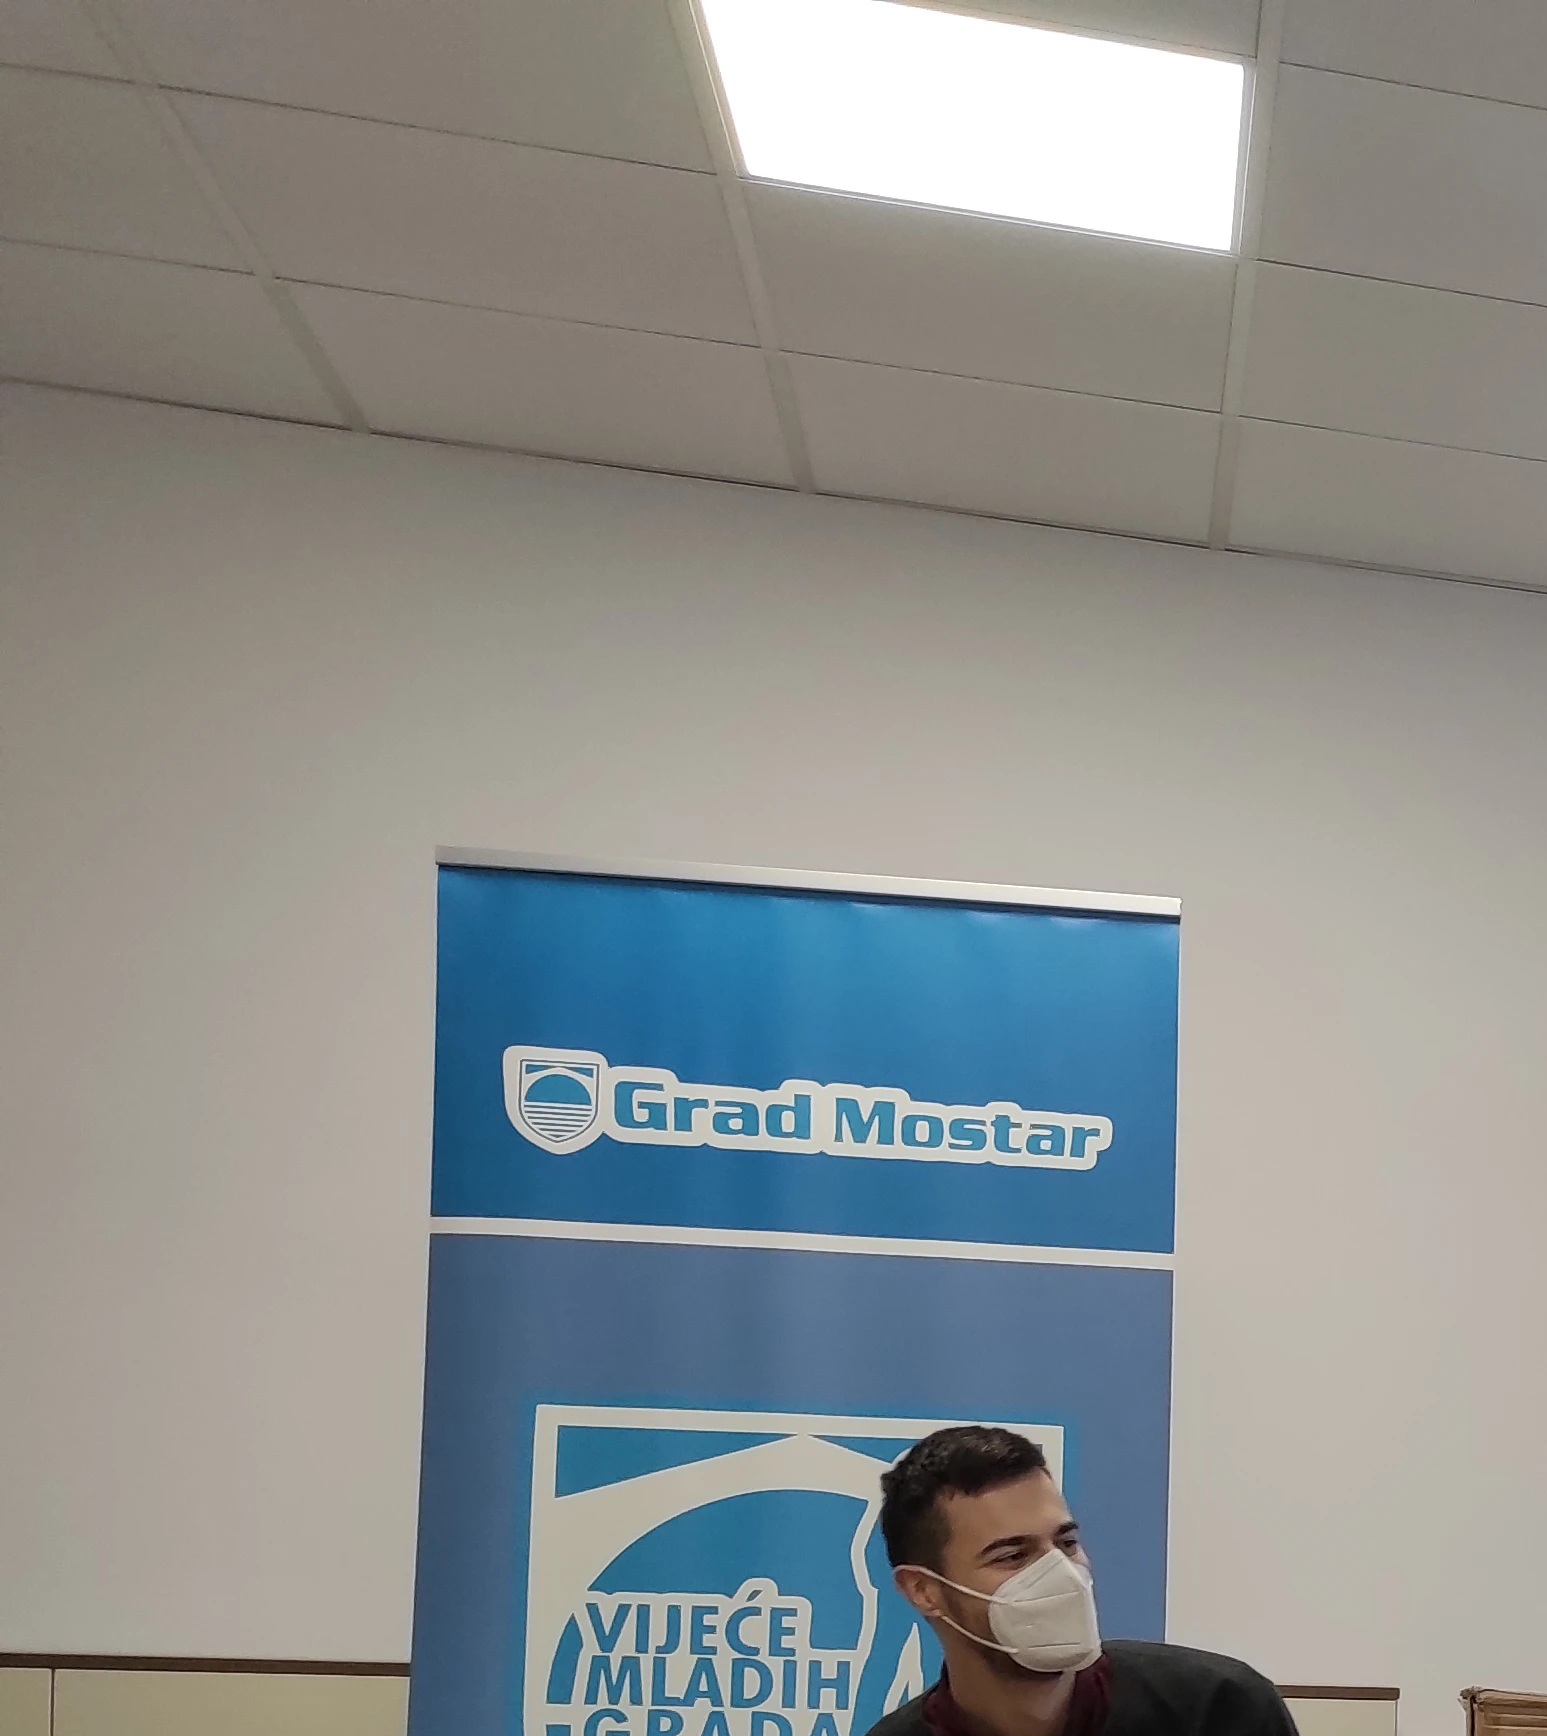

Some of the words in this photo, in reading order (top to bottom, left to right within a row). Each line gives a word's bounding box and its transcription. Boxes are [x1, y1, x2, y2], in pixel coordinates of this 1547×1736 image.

[613, 1080, 813, 1140] Grad
[833, 1097, 1103, 1160] Mostar
[585, 1589, 800, 1658] VIJEĆE
[583, 1656, 852, 1712] MLADIH
